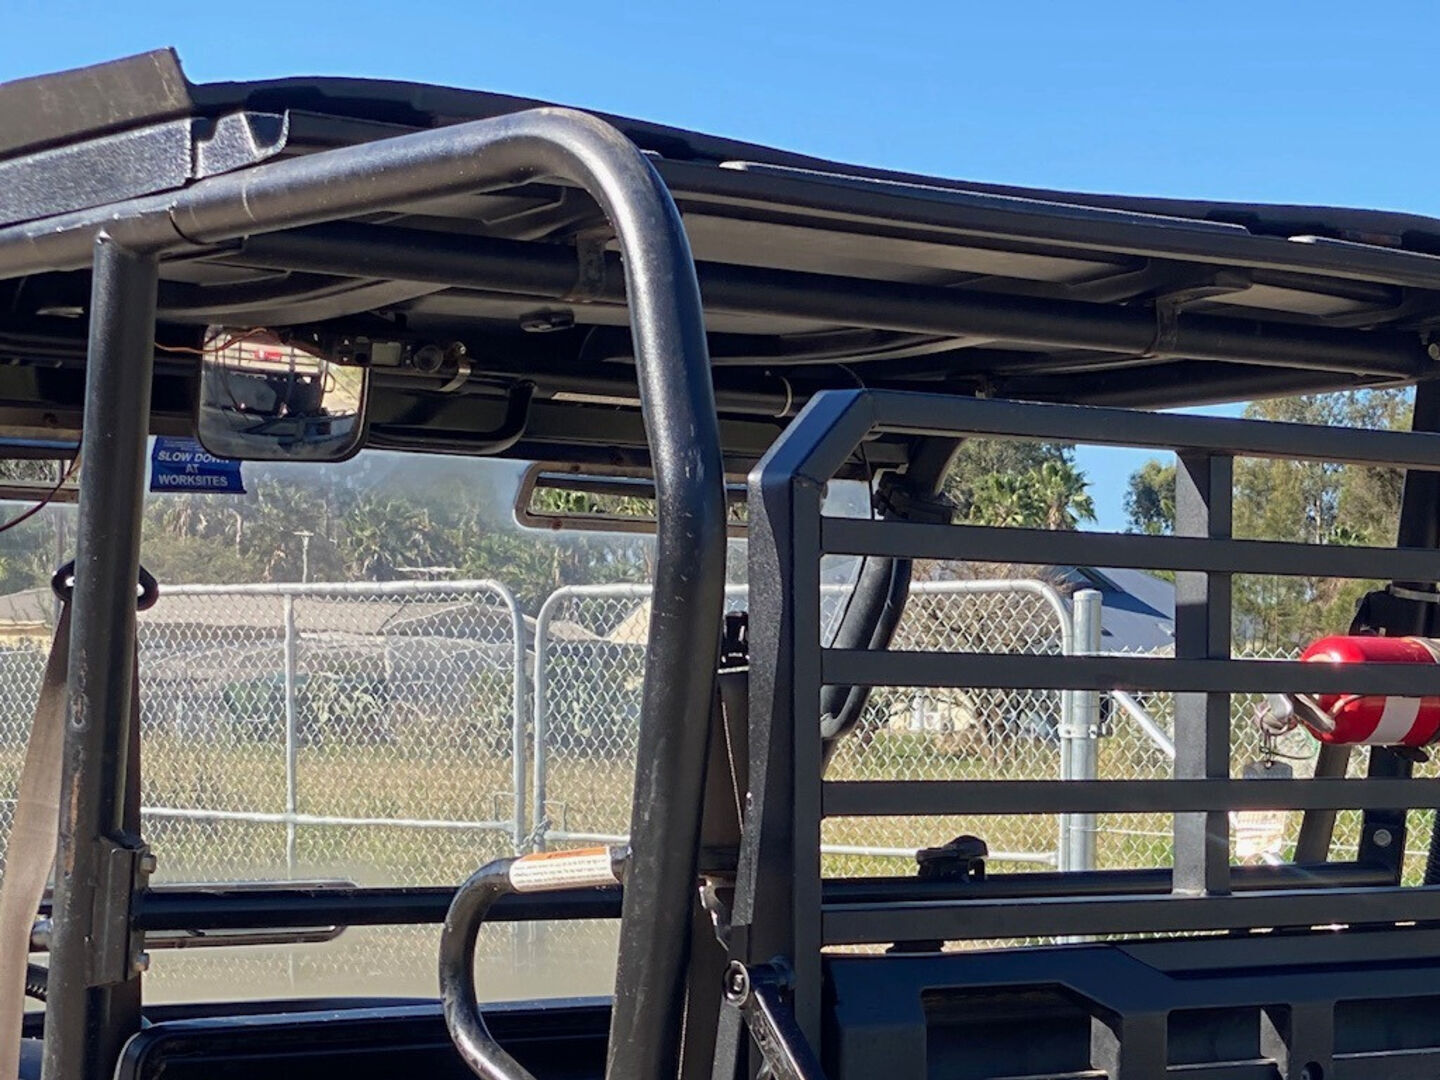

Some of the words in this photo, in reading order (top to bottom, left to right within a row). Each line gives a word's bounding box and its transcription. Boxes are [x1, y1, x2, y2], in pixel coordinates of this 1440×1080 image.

[157, 450, 192, 462] SLOW
[185, 464, 199, 473] AT
[158, 475, 229, 486] WORKSITES
